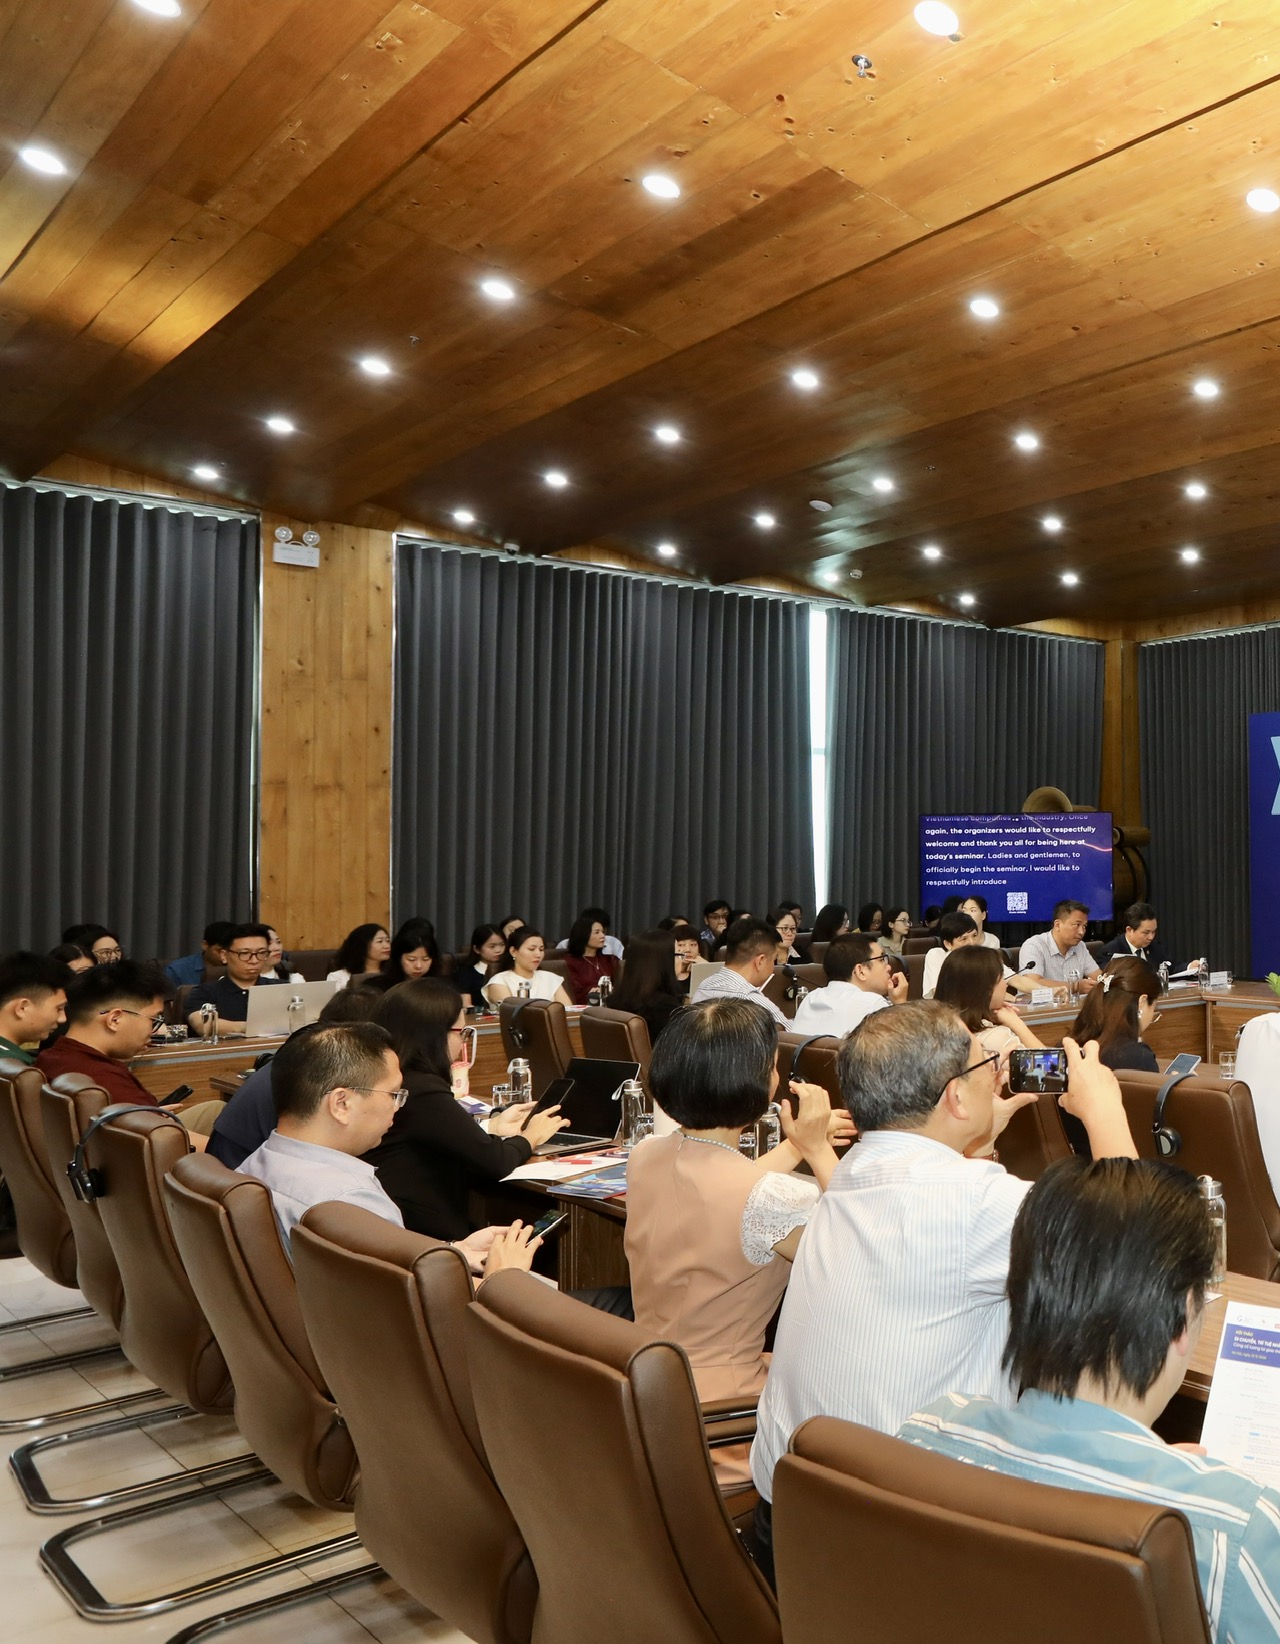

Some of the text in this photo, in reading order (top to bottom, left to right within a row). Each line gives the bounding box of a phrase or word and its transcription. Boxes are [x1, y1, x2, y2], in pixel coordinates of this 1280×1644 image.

[926, 828, 948, 836] again,
[964, 827, 1003, 836] organizers
[1052, 826, 1096, 834] respectfully
[1037, 839, 1058, 847] being
[926, 853, 953, 861] today's
[1030, 852, 1070, 860] gentlemen,
[926, 866, 958, 874] officially
[960, 866, 981, 874] begin
[926, 878, 970, 886] respectfully
